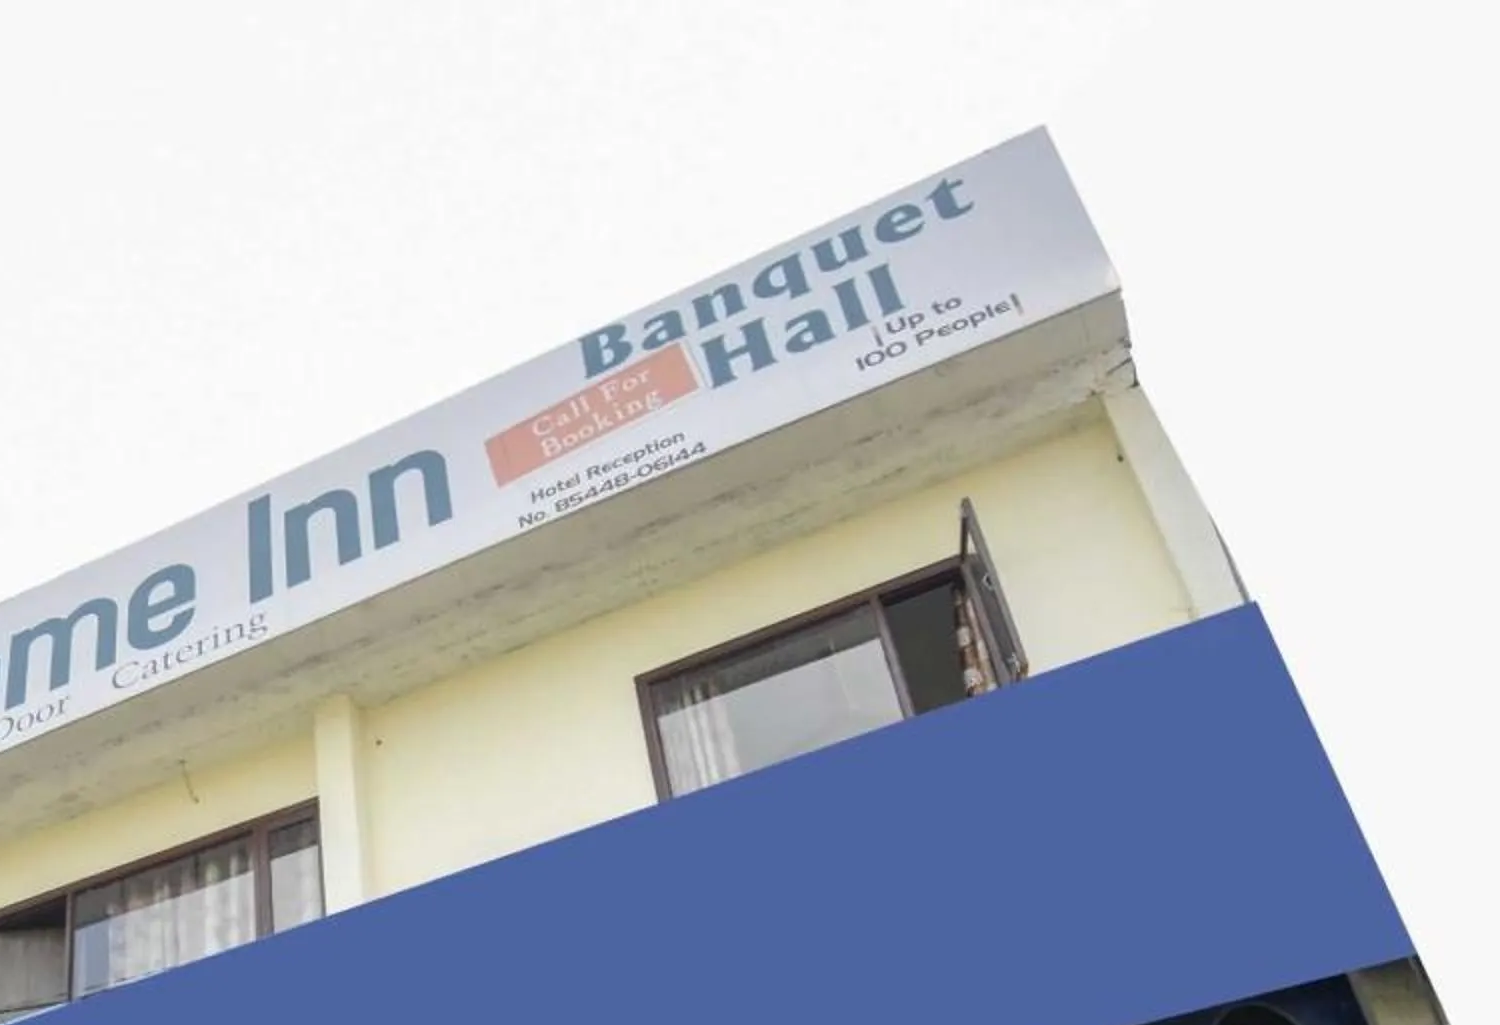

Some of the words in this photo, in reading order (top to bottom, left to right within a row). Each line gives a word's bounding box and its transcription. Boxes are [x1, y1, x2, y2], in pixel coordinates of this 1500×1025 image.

[578, 177, 975, 379] Banquet
[700, 263, 905, 389] Hall
[856, 341, 907, 371] 100
[914, 299, 1012, 347] People
[886, 312, 925, 335] Up
[931, 297, 963, 315] to
[532, 396, 591, 437] Call
[598, 369, 651, 401] For
[540, 388, 664, 459] Booking
[530, 473, 582, 504] Hotel
[585, 430, 687, 480] Reception
[248, 448, 453, 602] Inn
[110, 610, 270, 691] Catering
